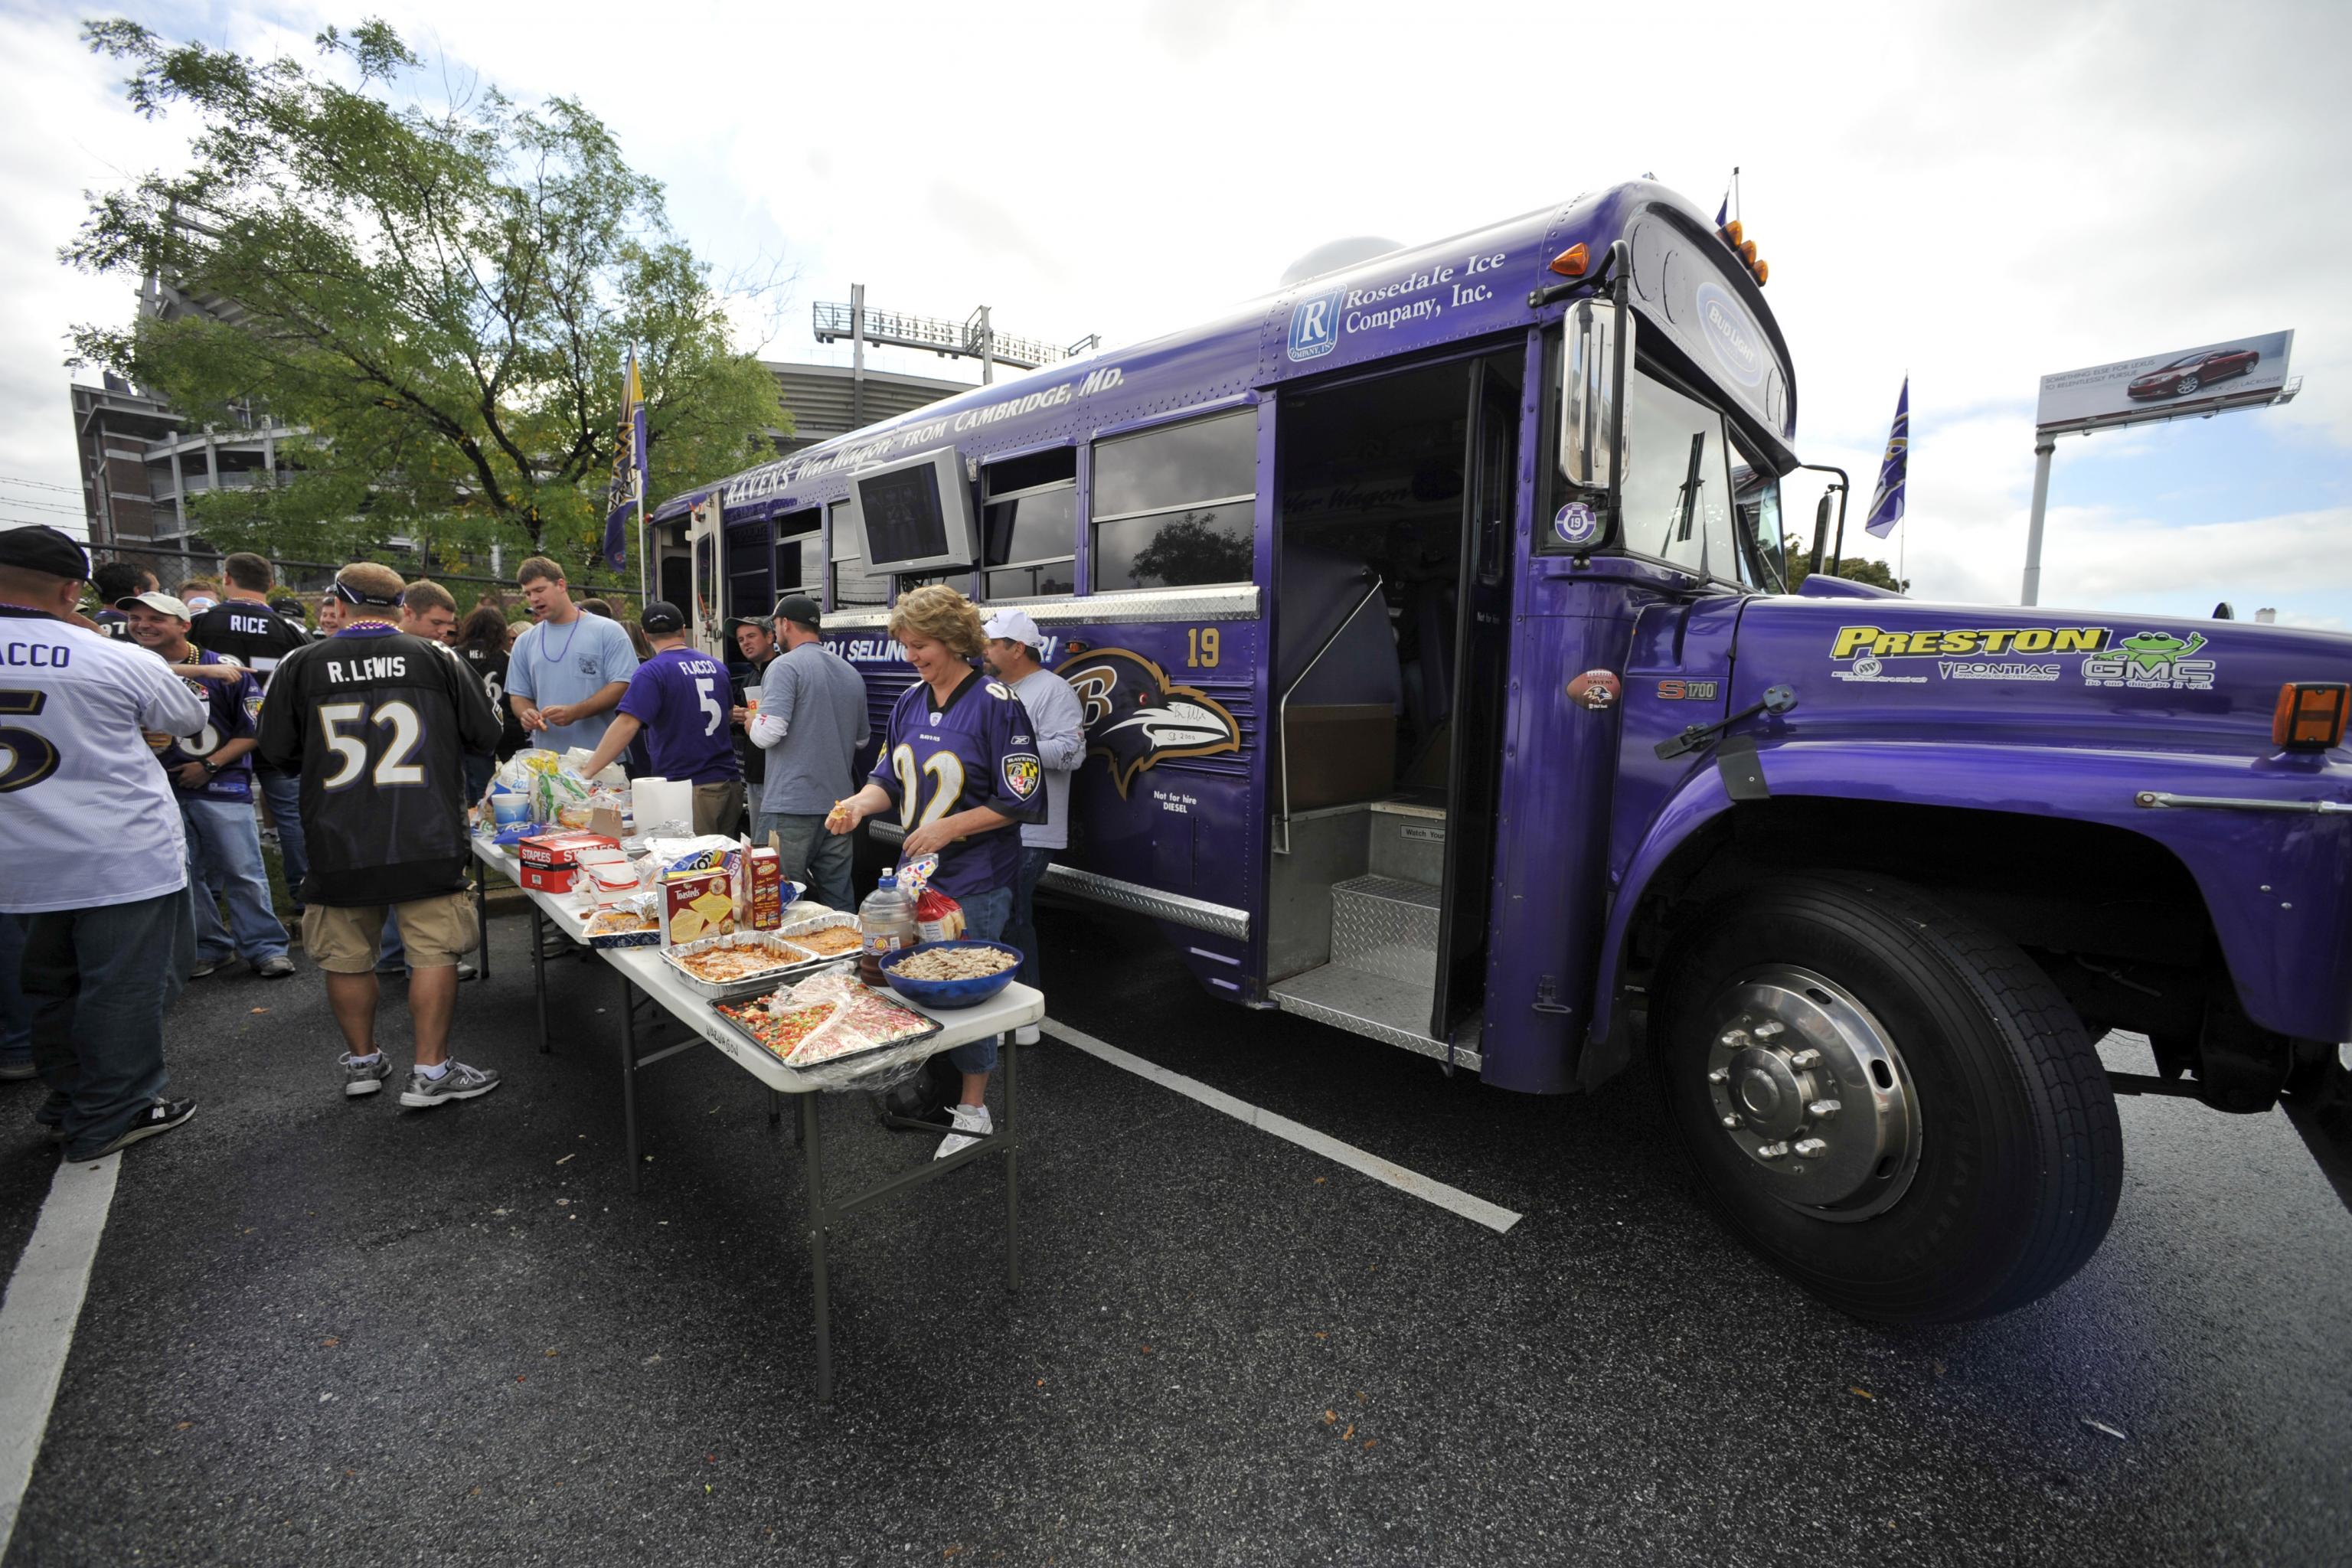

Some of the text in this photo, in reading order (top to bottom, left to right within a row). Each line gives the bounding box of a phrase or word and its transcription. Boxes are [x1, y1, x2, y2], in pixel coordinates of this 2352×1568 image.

[1344, 266, 1454, 310] Rosedale
[1465, 252, 1506, 276] Ice
[1346, 283, 1493, 334] Company, Inc.
[1300, 299, 1328, 343] R
[2045, 359, 2156, 384] SOMETHING ELSE FOR LEXUS
[2057, 375, 2106, 389] RELENTLESSLY
[725, 465, 794, 505] RAVENS
[1570, 517, 1581, 528] 19
[230, 615, 269, 635] RICE
[1187, 627, 1220, 668] 19
[1831, 626, 2109, 660] PRESTON
[0, 642, 70, 668] CCO
[678, 660, 717, 675] FLACCO
[1955, 664, 2060, 675] PONTIAC
[2083, 660, 2214, 681] GMC
[695, 678, 722, 737] 5
[318, 700, 427, 792] 52
[920, 733, 940, 742] RAVENS
[1154, 790, 1197, 805] Not for hire
[1163, 802, 1187, 814] DIESEL
[1406, 828, 1426, 838] Watch
[522, 848, 551, 864] STAPLES
[675, 887, 701, 901] Toasteds
[459, 1076, 470, 1085] N
